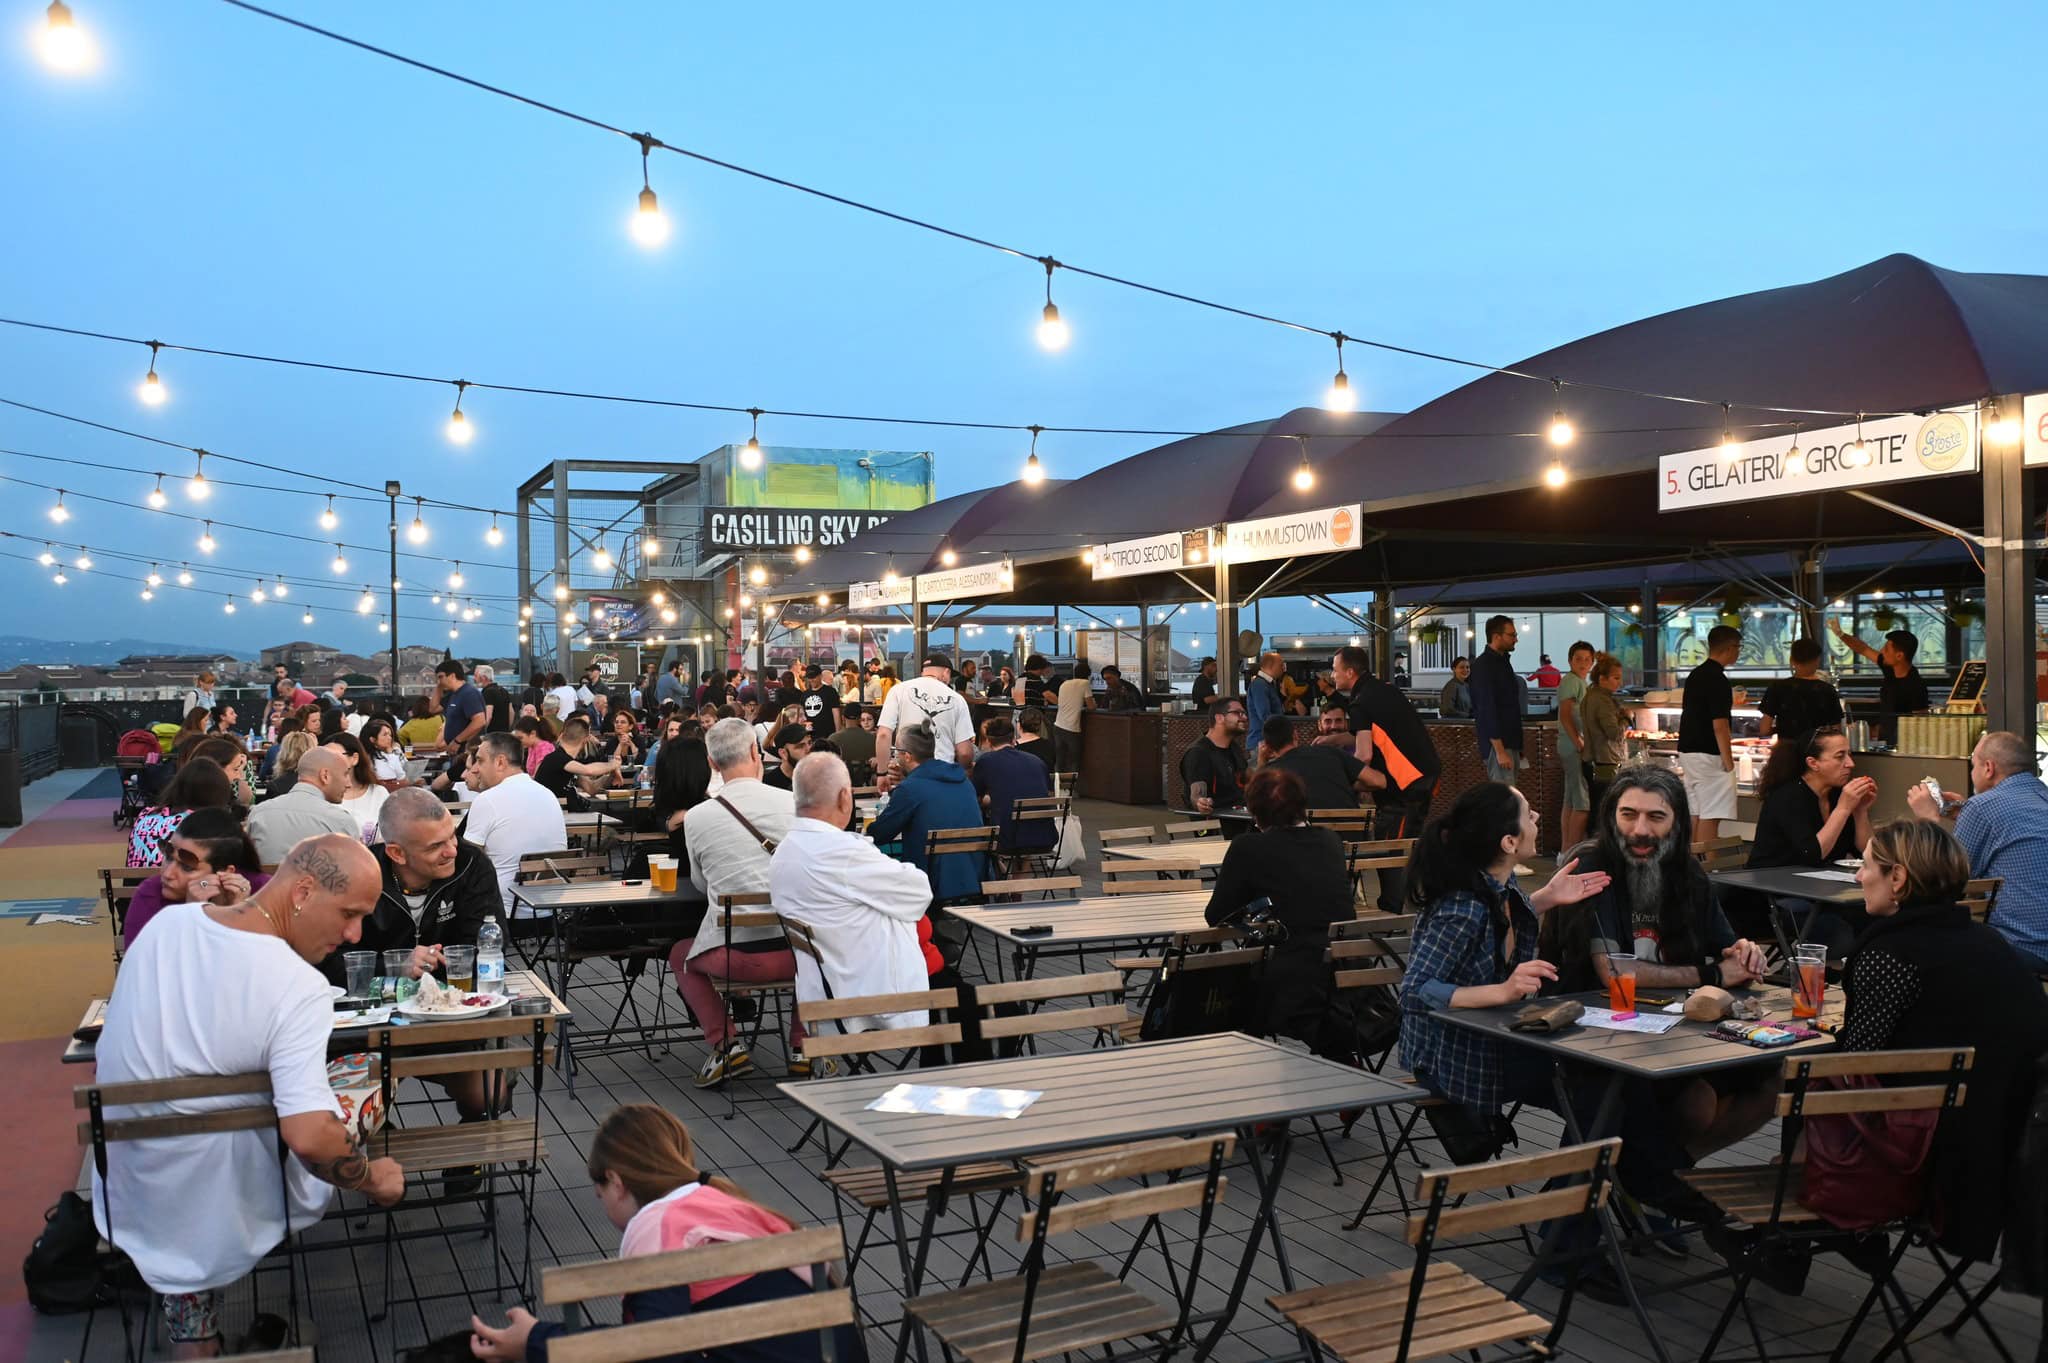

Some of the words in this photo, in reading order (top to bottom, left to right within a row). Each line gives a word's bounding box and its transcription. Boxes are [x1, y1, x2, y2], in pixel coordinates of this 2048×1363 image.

[1667, 470, 1681, 495] 5.
[711, 513, 813, 545] CASILINO
[819, 515, 861, 546] SKY
[1243, 520, 1328, 546] HUMMUSTOWN
[1144, 543, 1181, 562] SECONDI
